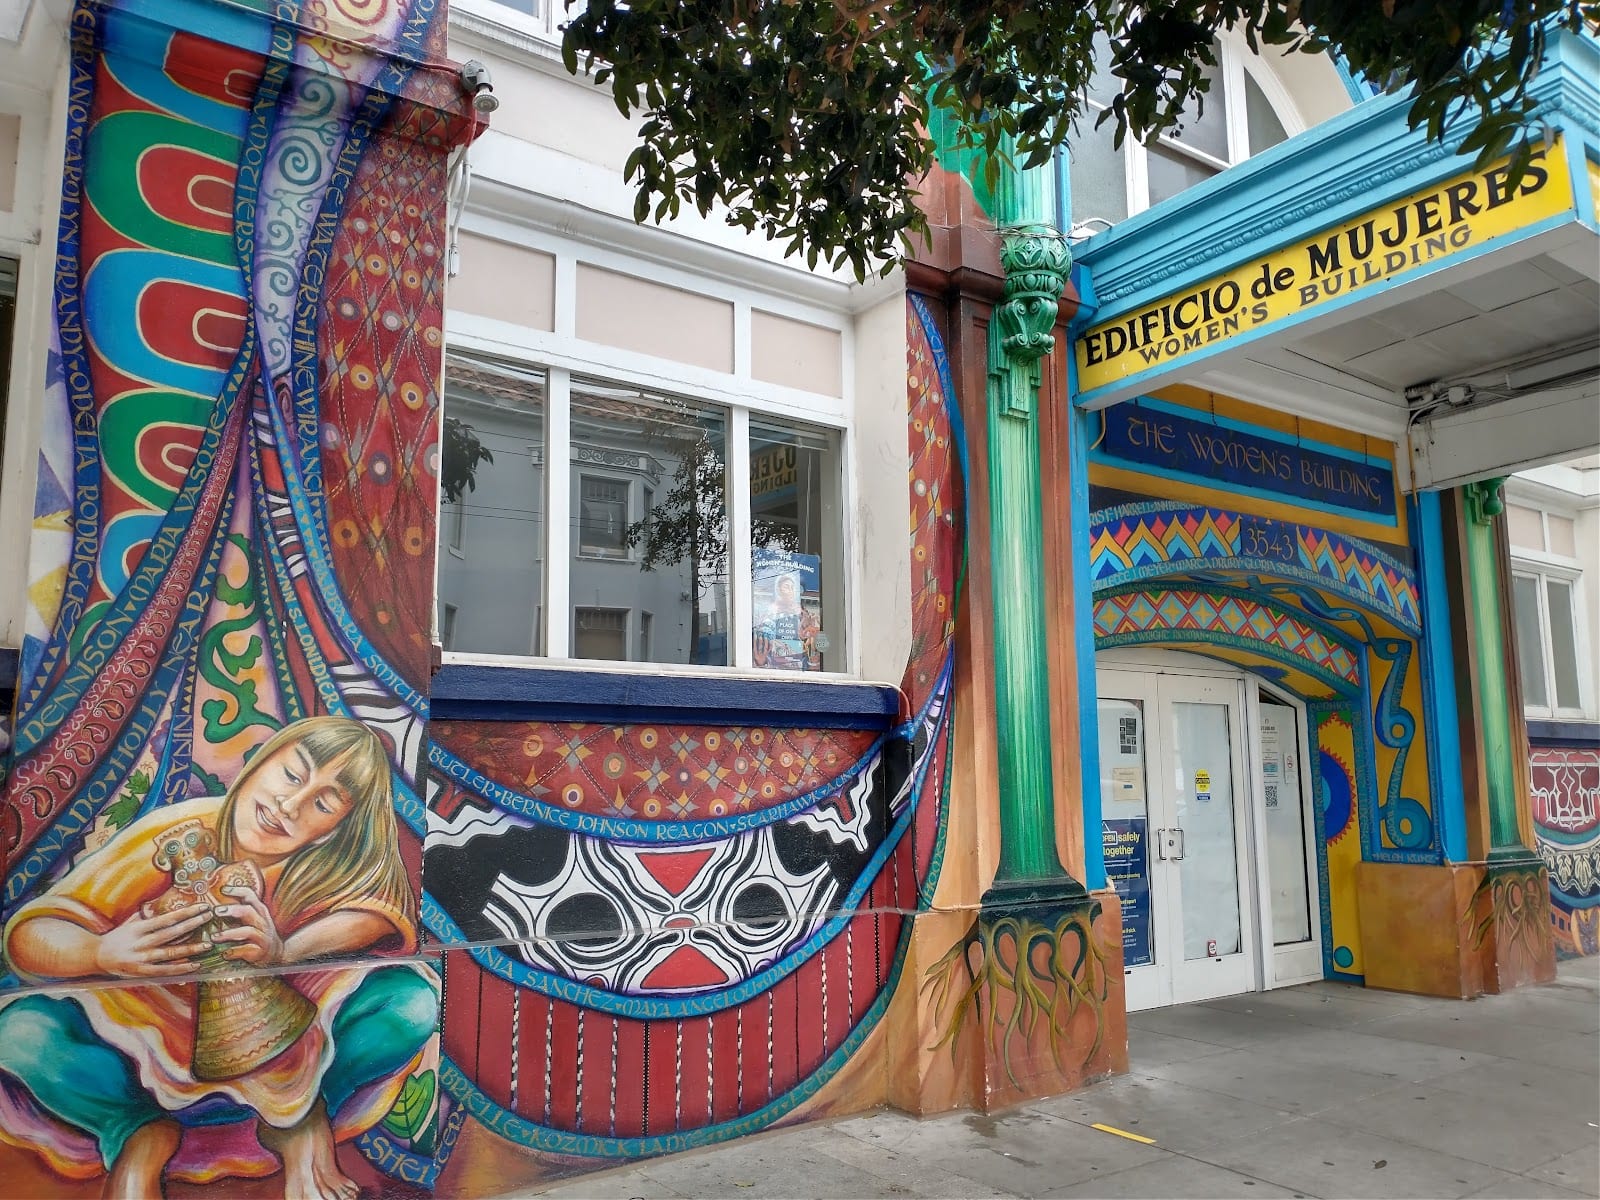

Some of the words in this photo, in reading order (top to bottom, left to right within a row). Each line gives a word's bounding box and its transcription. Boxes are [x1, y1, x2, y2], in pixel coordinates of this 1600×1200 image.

[59, 136, 83, 246] CAROLYN
[325, 140, 362, 206] ALICE
[56, 255, 85, 361] BRANDY
[294, 211, 339, 321] WATERS
[1084, 280, 1241, 367] EDIFICIO
[1251, 263, 1295, 299] de
[1306, 149, 1549, 281] MUJERES
[1139, 301, 1270, 365] WOMEN'S
[1298, 224, 1473, 308] BUILDING
[69, 370, 98, 472] ODELIA
[1127, 415, 1176, 453] THE
[1187, 432, 1292, 481] WOMEN'S
[1300, 458, 1382, 505] BUILDING
[129, 525, 186, 602] MARIA
[174, 389, 236, 514] VASQUEZ
[1245, 527, 1295, 561] 3543
[54, 485, 99, 639] RODRIGUEZ
[22, 607, 128, 745] DENNISON
[115, 679, 167, 773] HOLLY
[167, 591, 210, 674] NEAR
[361, 653, 423, 708] SMITH
[428, 744, 496, 797] BUTLER
[500, 790, 570, 826] BERNICE
[577, 814, 649, 839] JOHNSON
[737, 790, 821, 831] STARHAWK
[1118, 832, 1140, 843] safely
[458, 939, 514, 979] ONIA
[522, 970, 616, 1012] SANCHEZ
[621, 999, 671, 1017] MAYA
